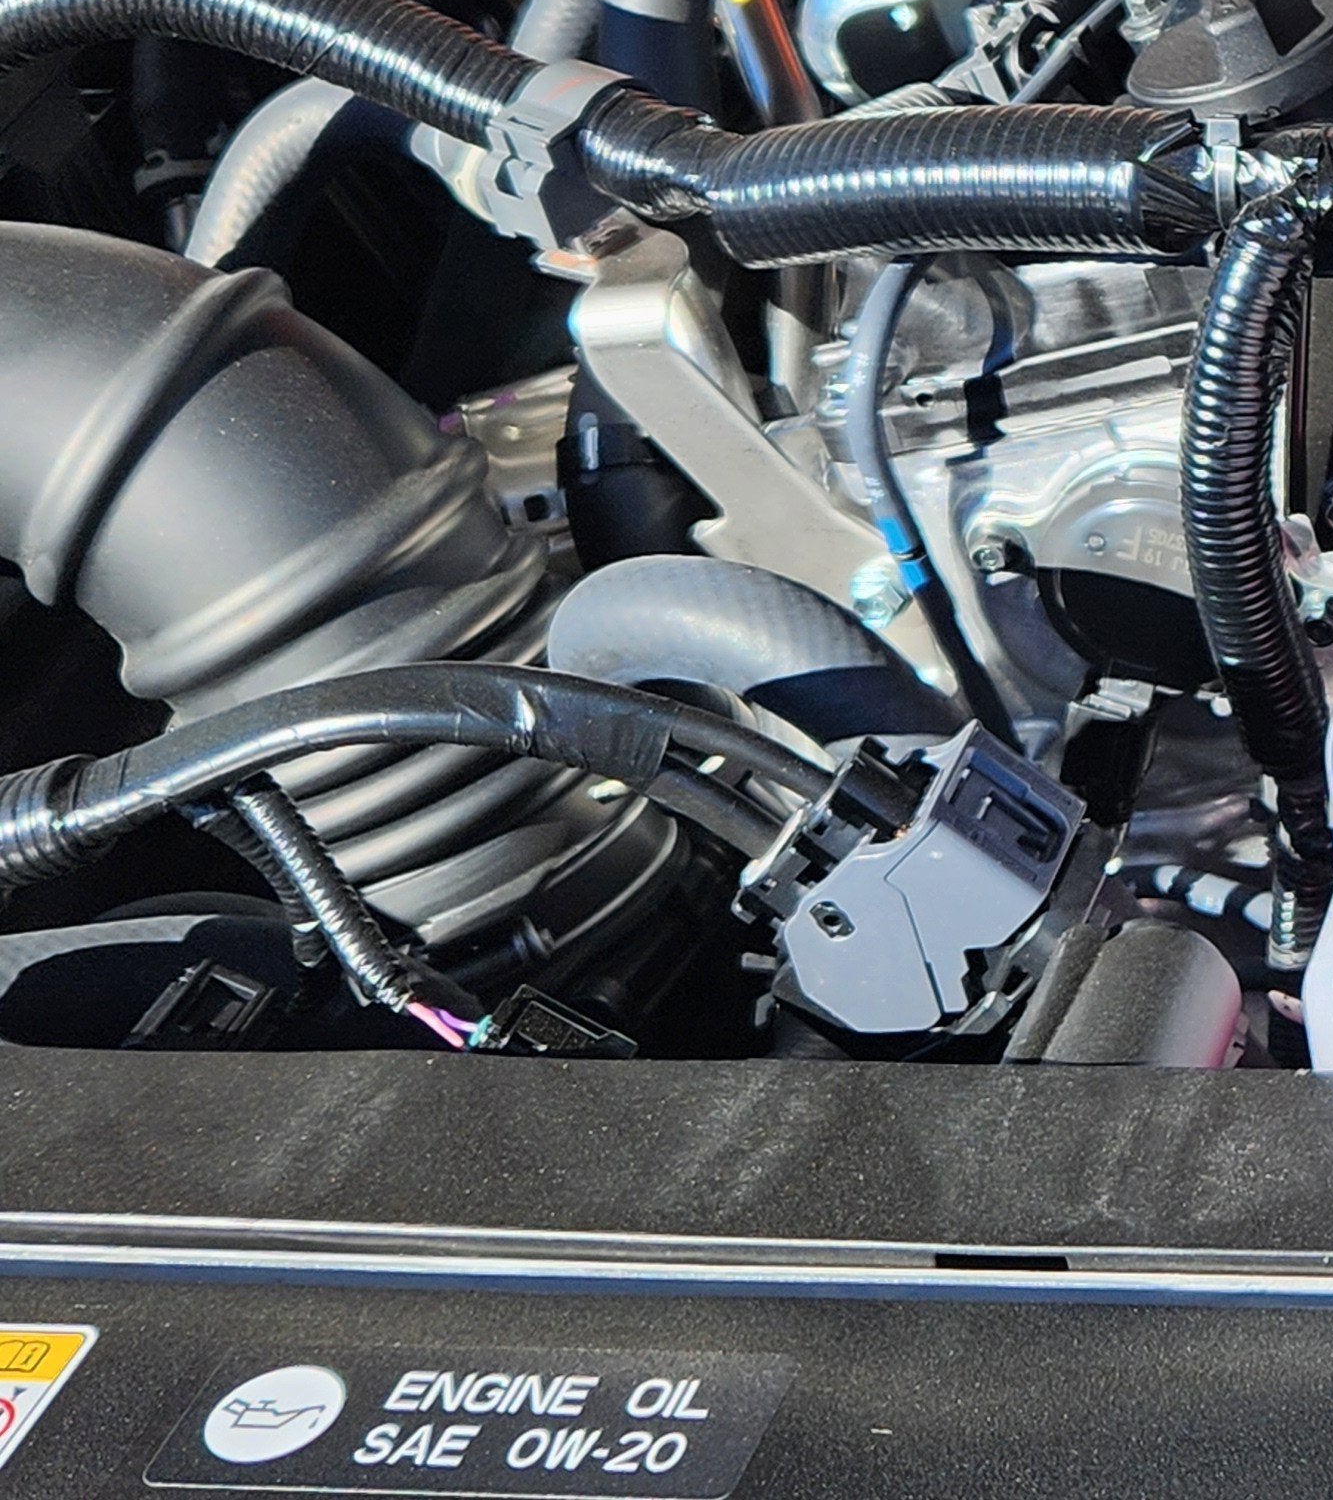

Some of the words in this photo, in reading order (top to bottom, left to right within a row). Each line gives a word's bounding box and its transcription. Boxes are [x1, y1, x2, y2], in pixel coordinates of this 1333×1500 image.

[383, 1370, 599, 1416] ENGINE
[625, 1378, 712, 1421] OIL
[353, 1424, 482, 1469] SAE
[505, 1428, 688, 1474] 0W-20
